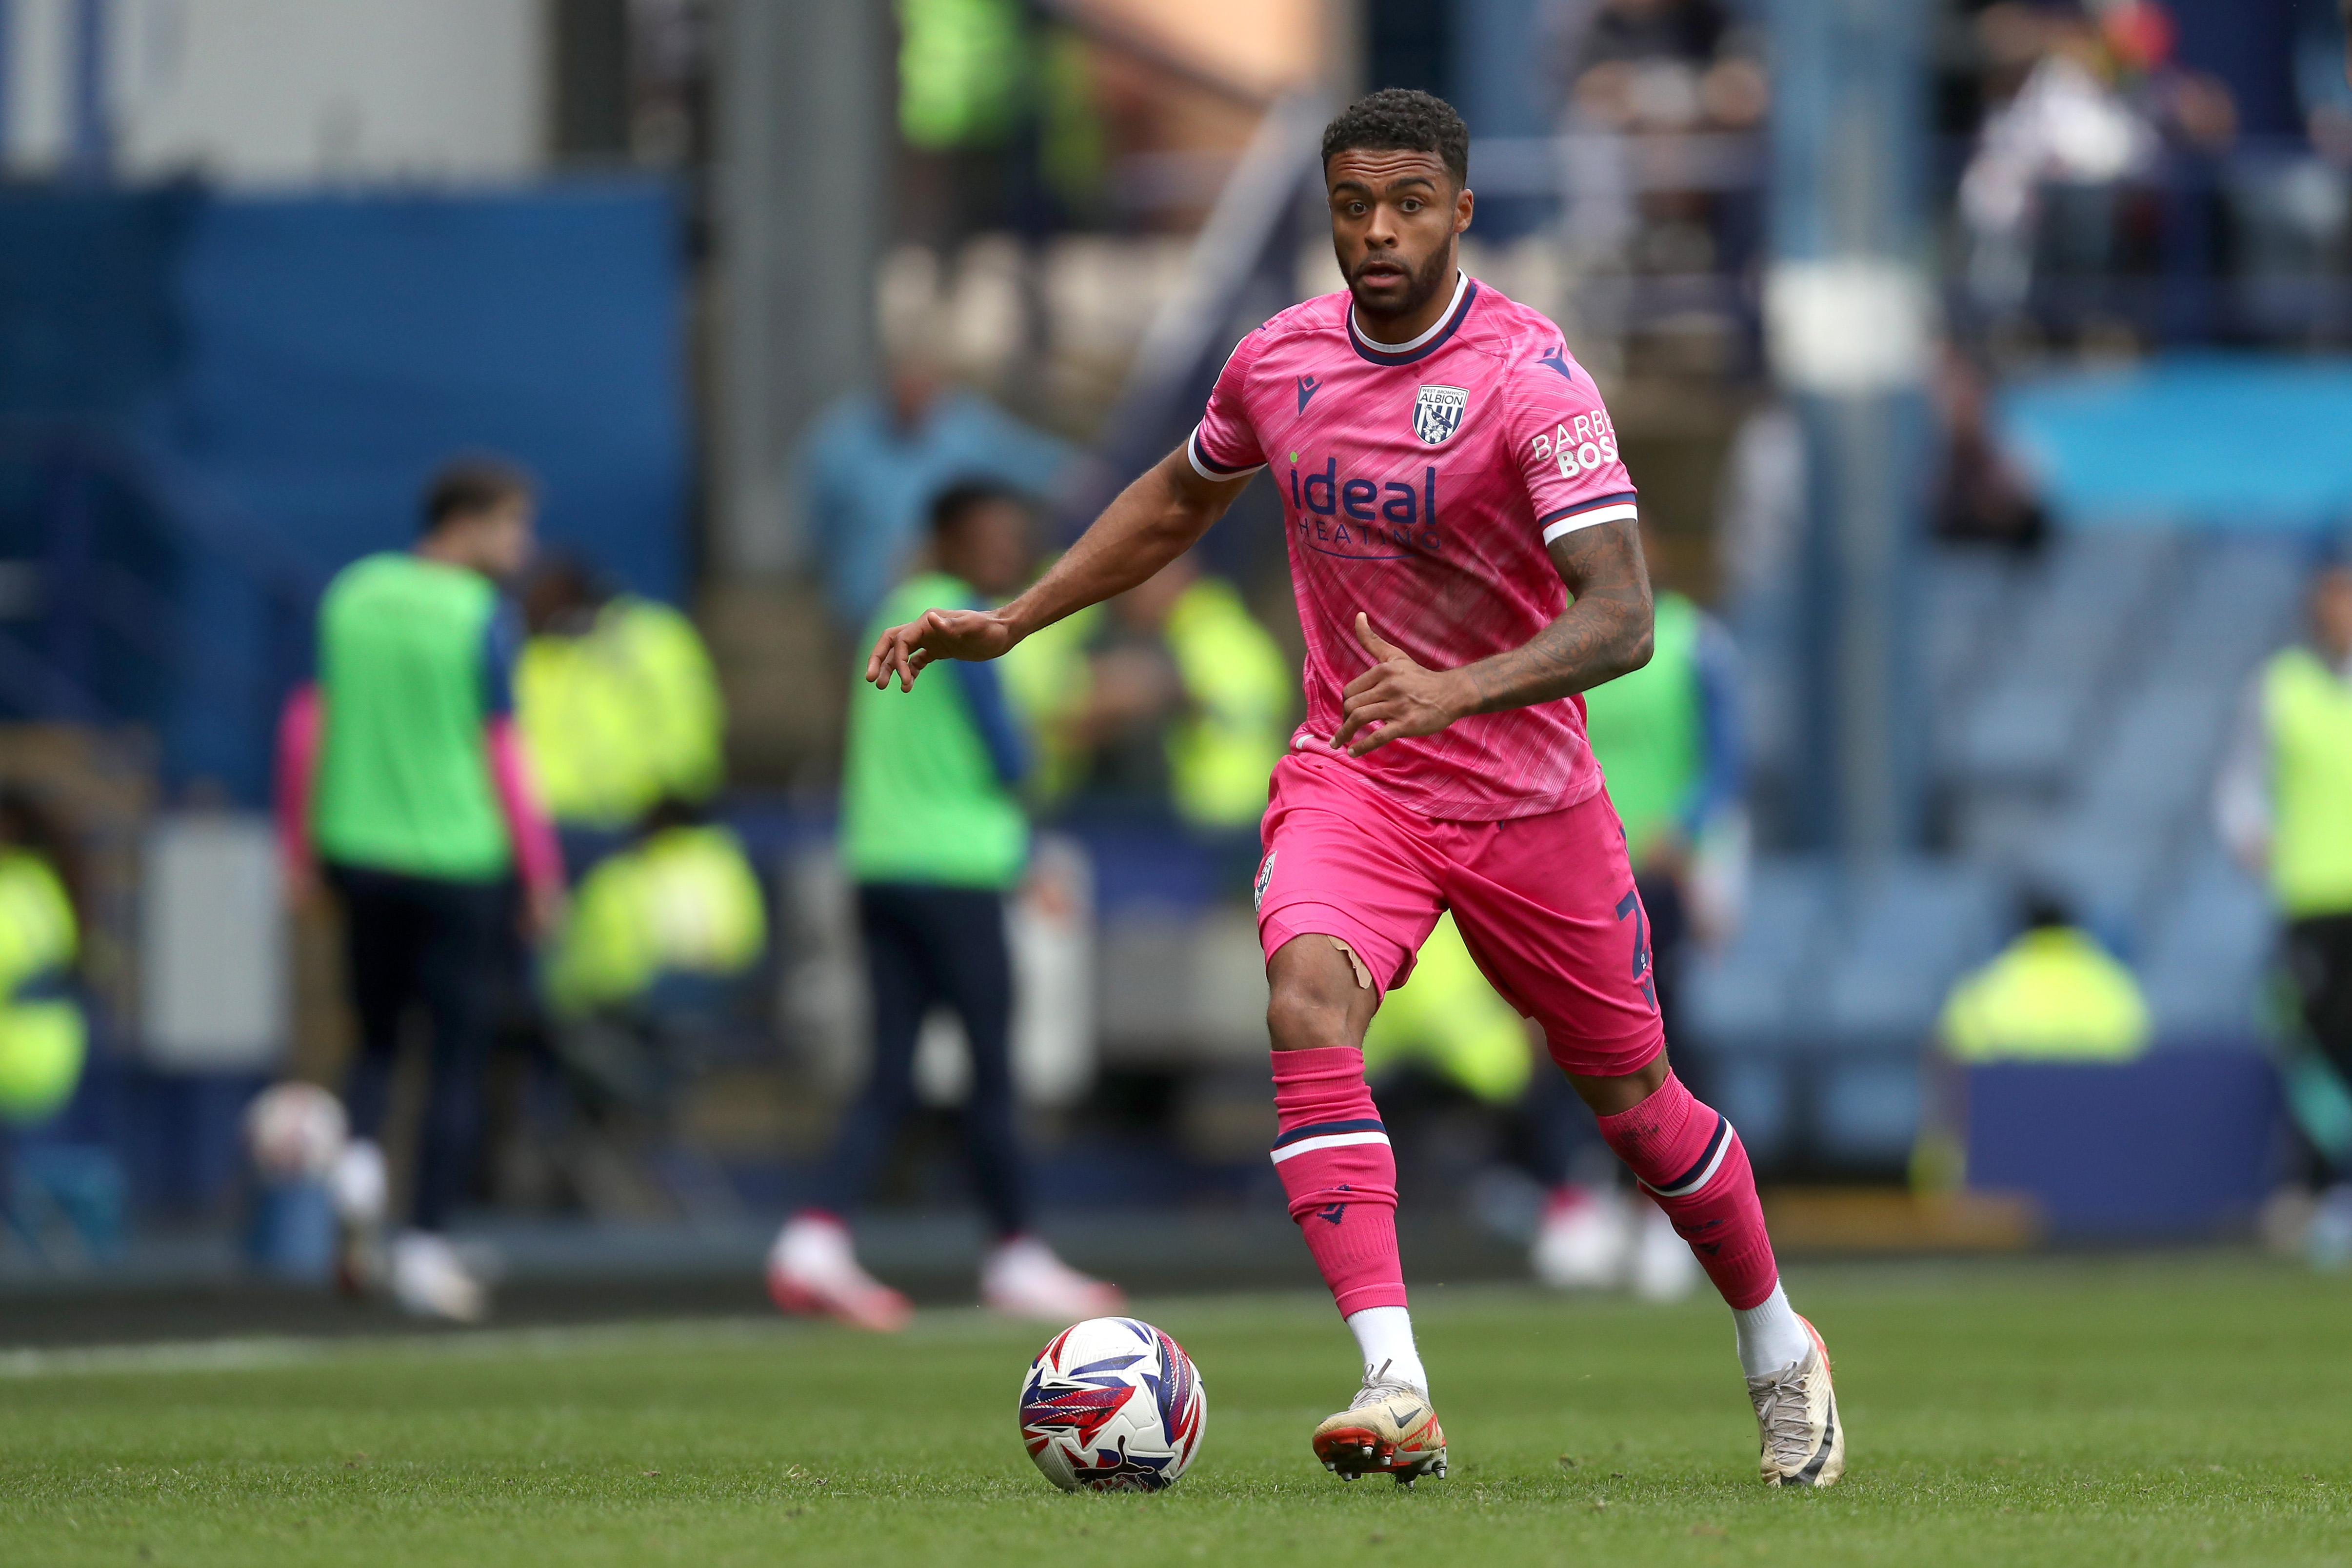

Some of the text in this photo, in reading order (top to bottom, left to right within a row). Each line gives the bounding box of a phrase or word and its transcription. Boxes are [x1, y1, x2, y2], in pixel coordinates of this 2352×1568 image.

[1420, 393, 1463, 405] ALBION
[1290, 451, 1435, 524] ideal
[1297, 516, 1440, 549] HEATING
